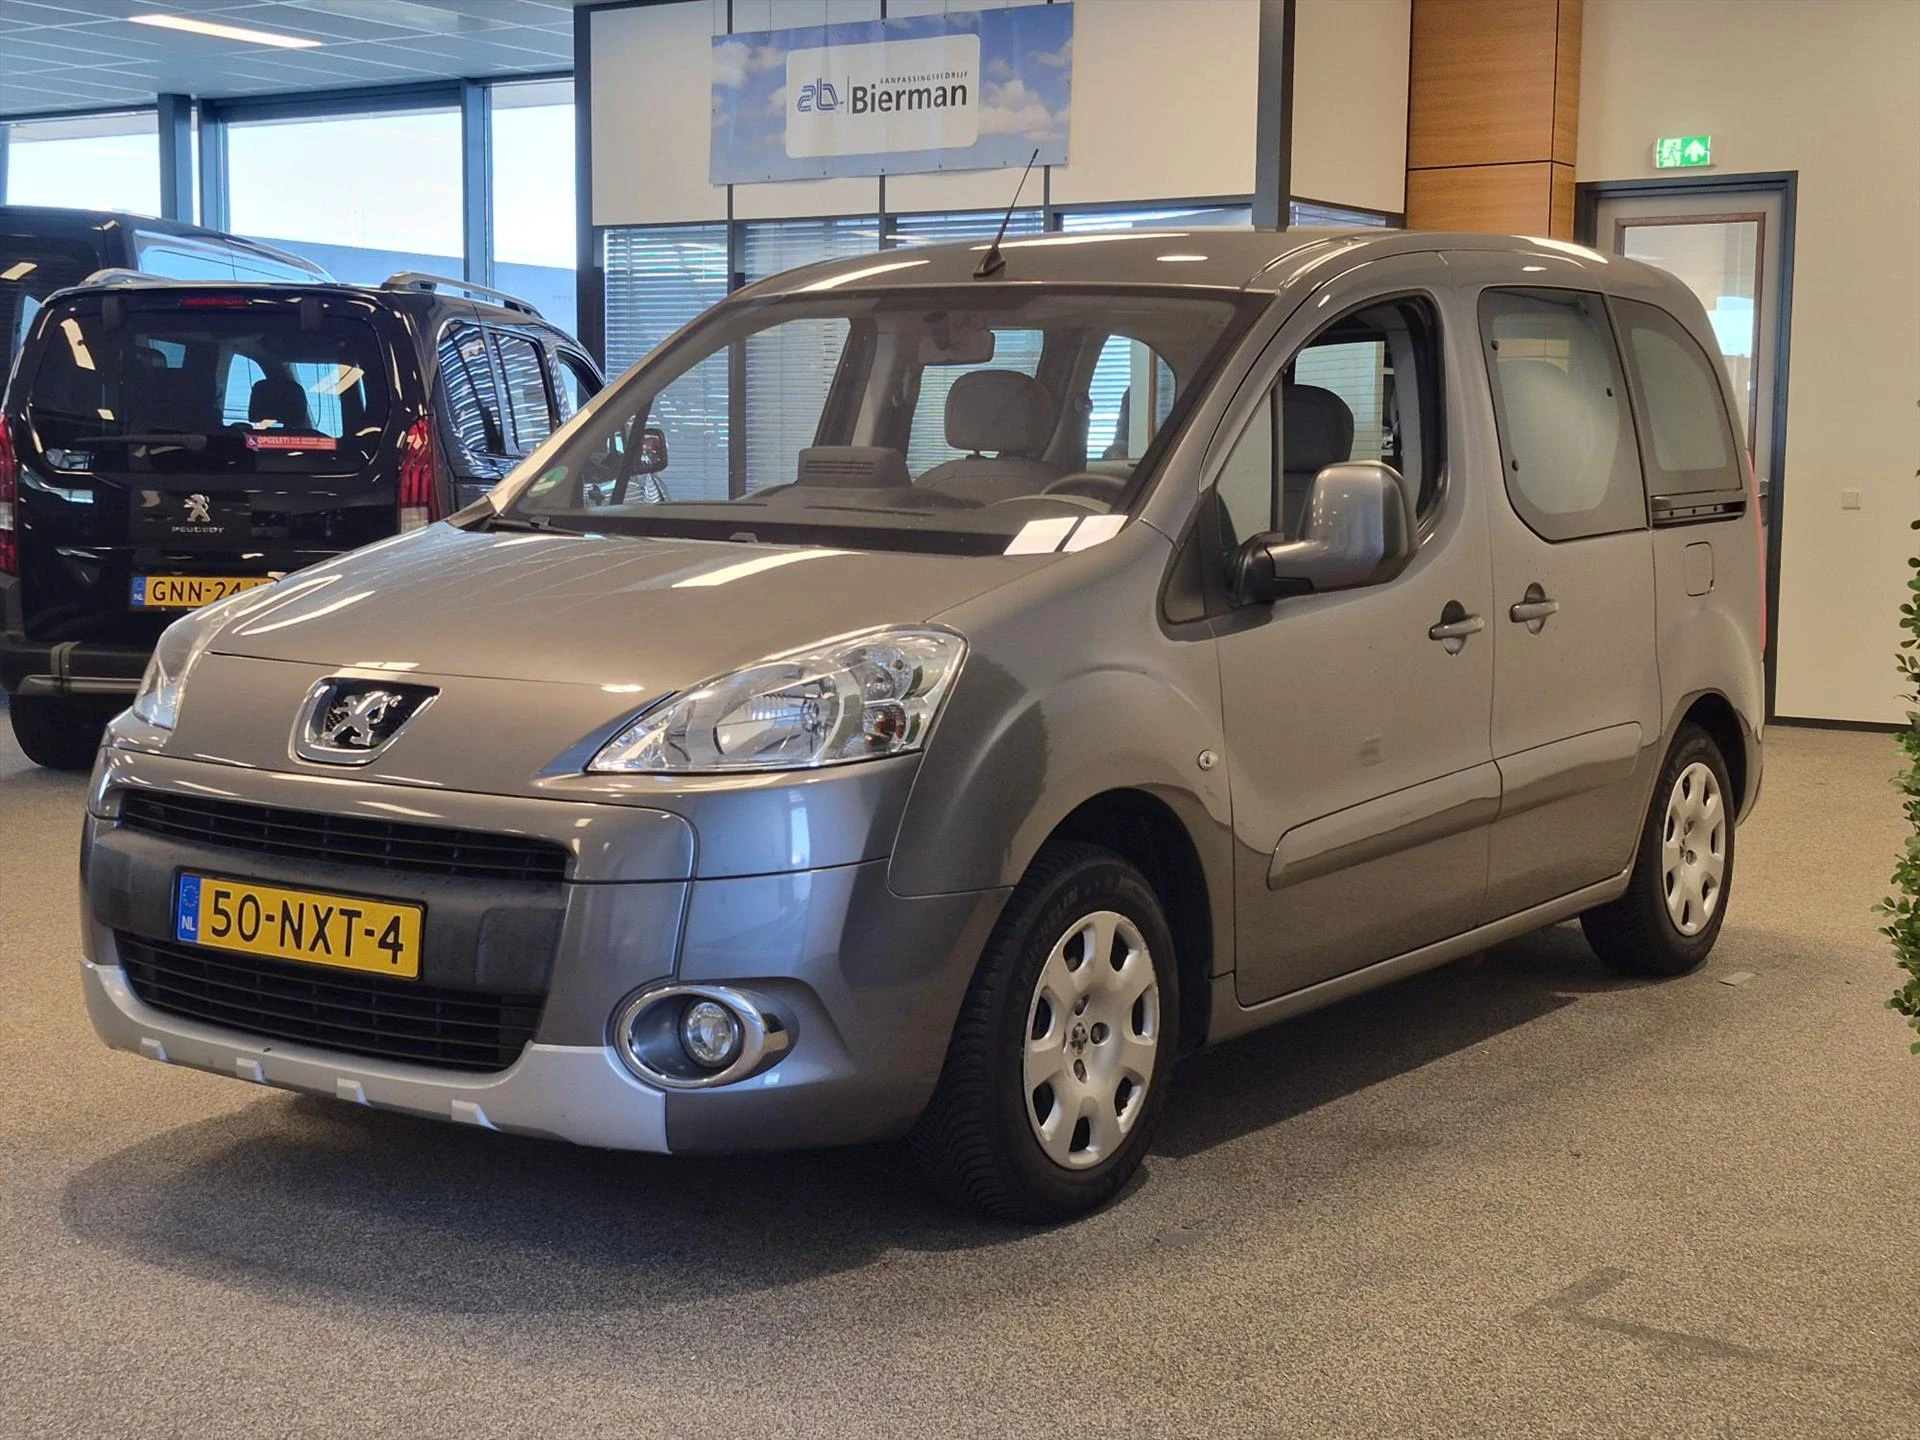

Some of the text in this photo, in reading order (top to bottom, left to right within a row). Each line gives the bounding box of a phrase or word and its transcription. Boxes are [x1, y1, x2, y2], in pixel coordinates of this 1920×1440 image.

[852, 84, 967, 114] Bierman
[181, 889, 404, 965] NL 50-NXT-4
